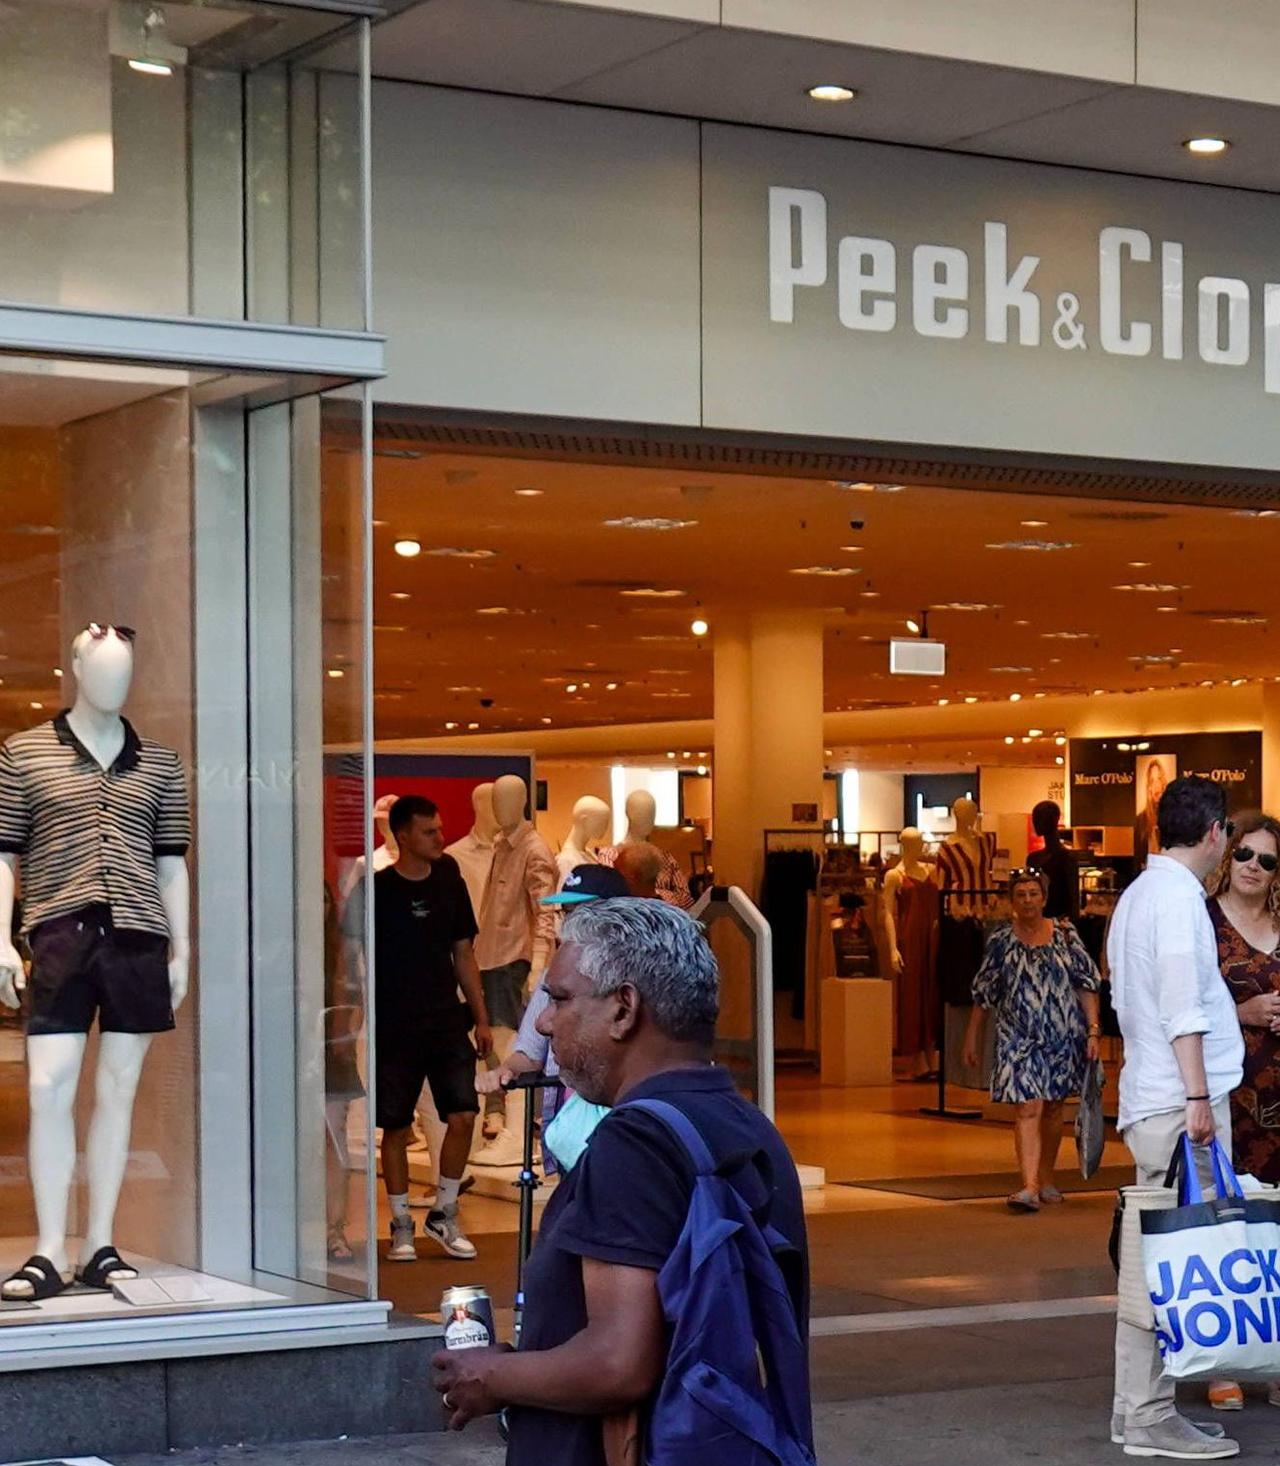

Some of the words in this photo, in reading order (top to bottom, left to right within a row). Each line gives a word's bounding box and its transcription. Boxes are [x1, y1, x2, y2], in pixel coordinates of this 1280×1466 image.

[1075, 773, 1100, 785] Marc
[1102, 771, 1133, 785] O'Polo
[1211, 769, 1246, 782] O'Polo
